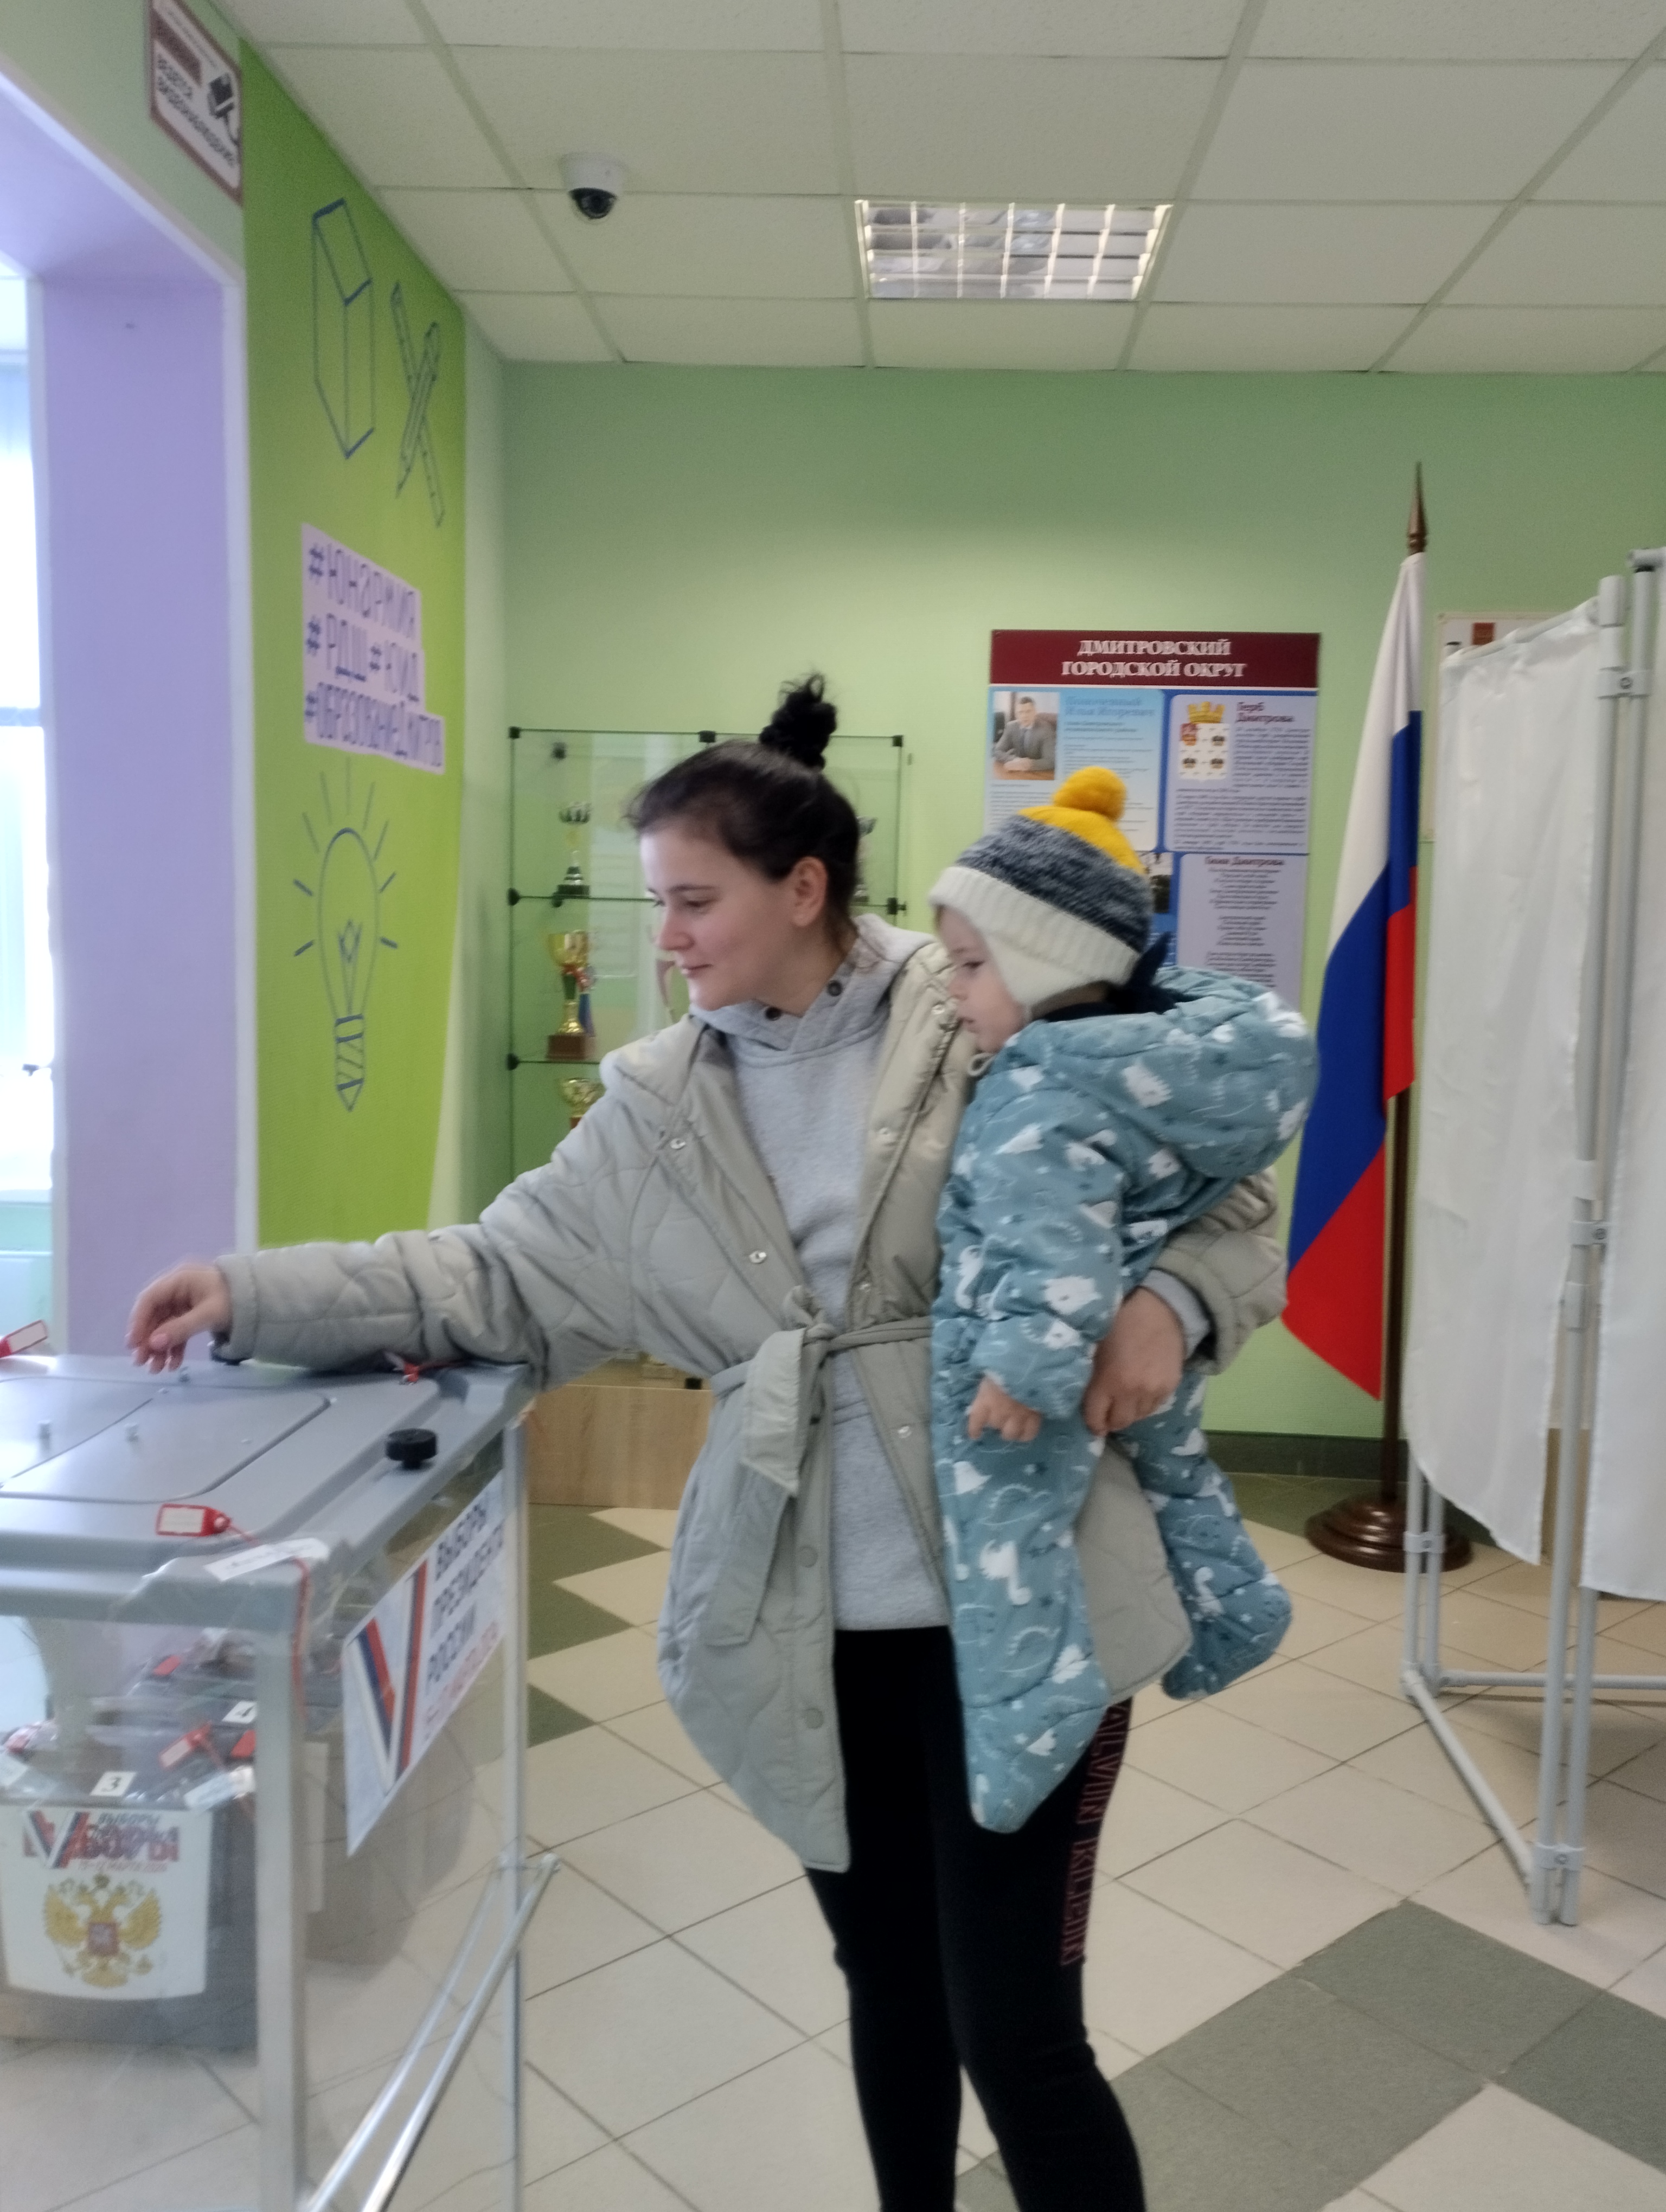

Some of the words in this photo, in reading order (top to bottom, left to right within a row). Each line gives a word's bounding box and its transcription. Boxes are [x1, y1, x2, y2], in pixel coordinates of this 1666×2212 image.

[306, 613, 367, 682] #РДШ
[1077, 639, 1232, 656] ДМИТРОВСКИЙ
[1061, 660, 1182, 678] ГОРОДСКОЙ
[1184, 663, 1247, 677] ОКРУГ
[1237, 702, 1265, 712] Герб
[1235, 713, 1295, 724] Дмитрова
[436, 1503, 487, 1582] ВЫБОРЫ
[1076, 1706, 1130, 1824] ALVIN
[99, 1776, 123, 1792] 3
[1061, 1837, 1099, 1965] KLEIN
